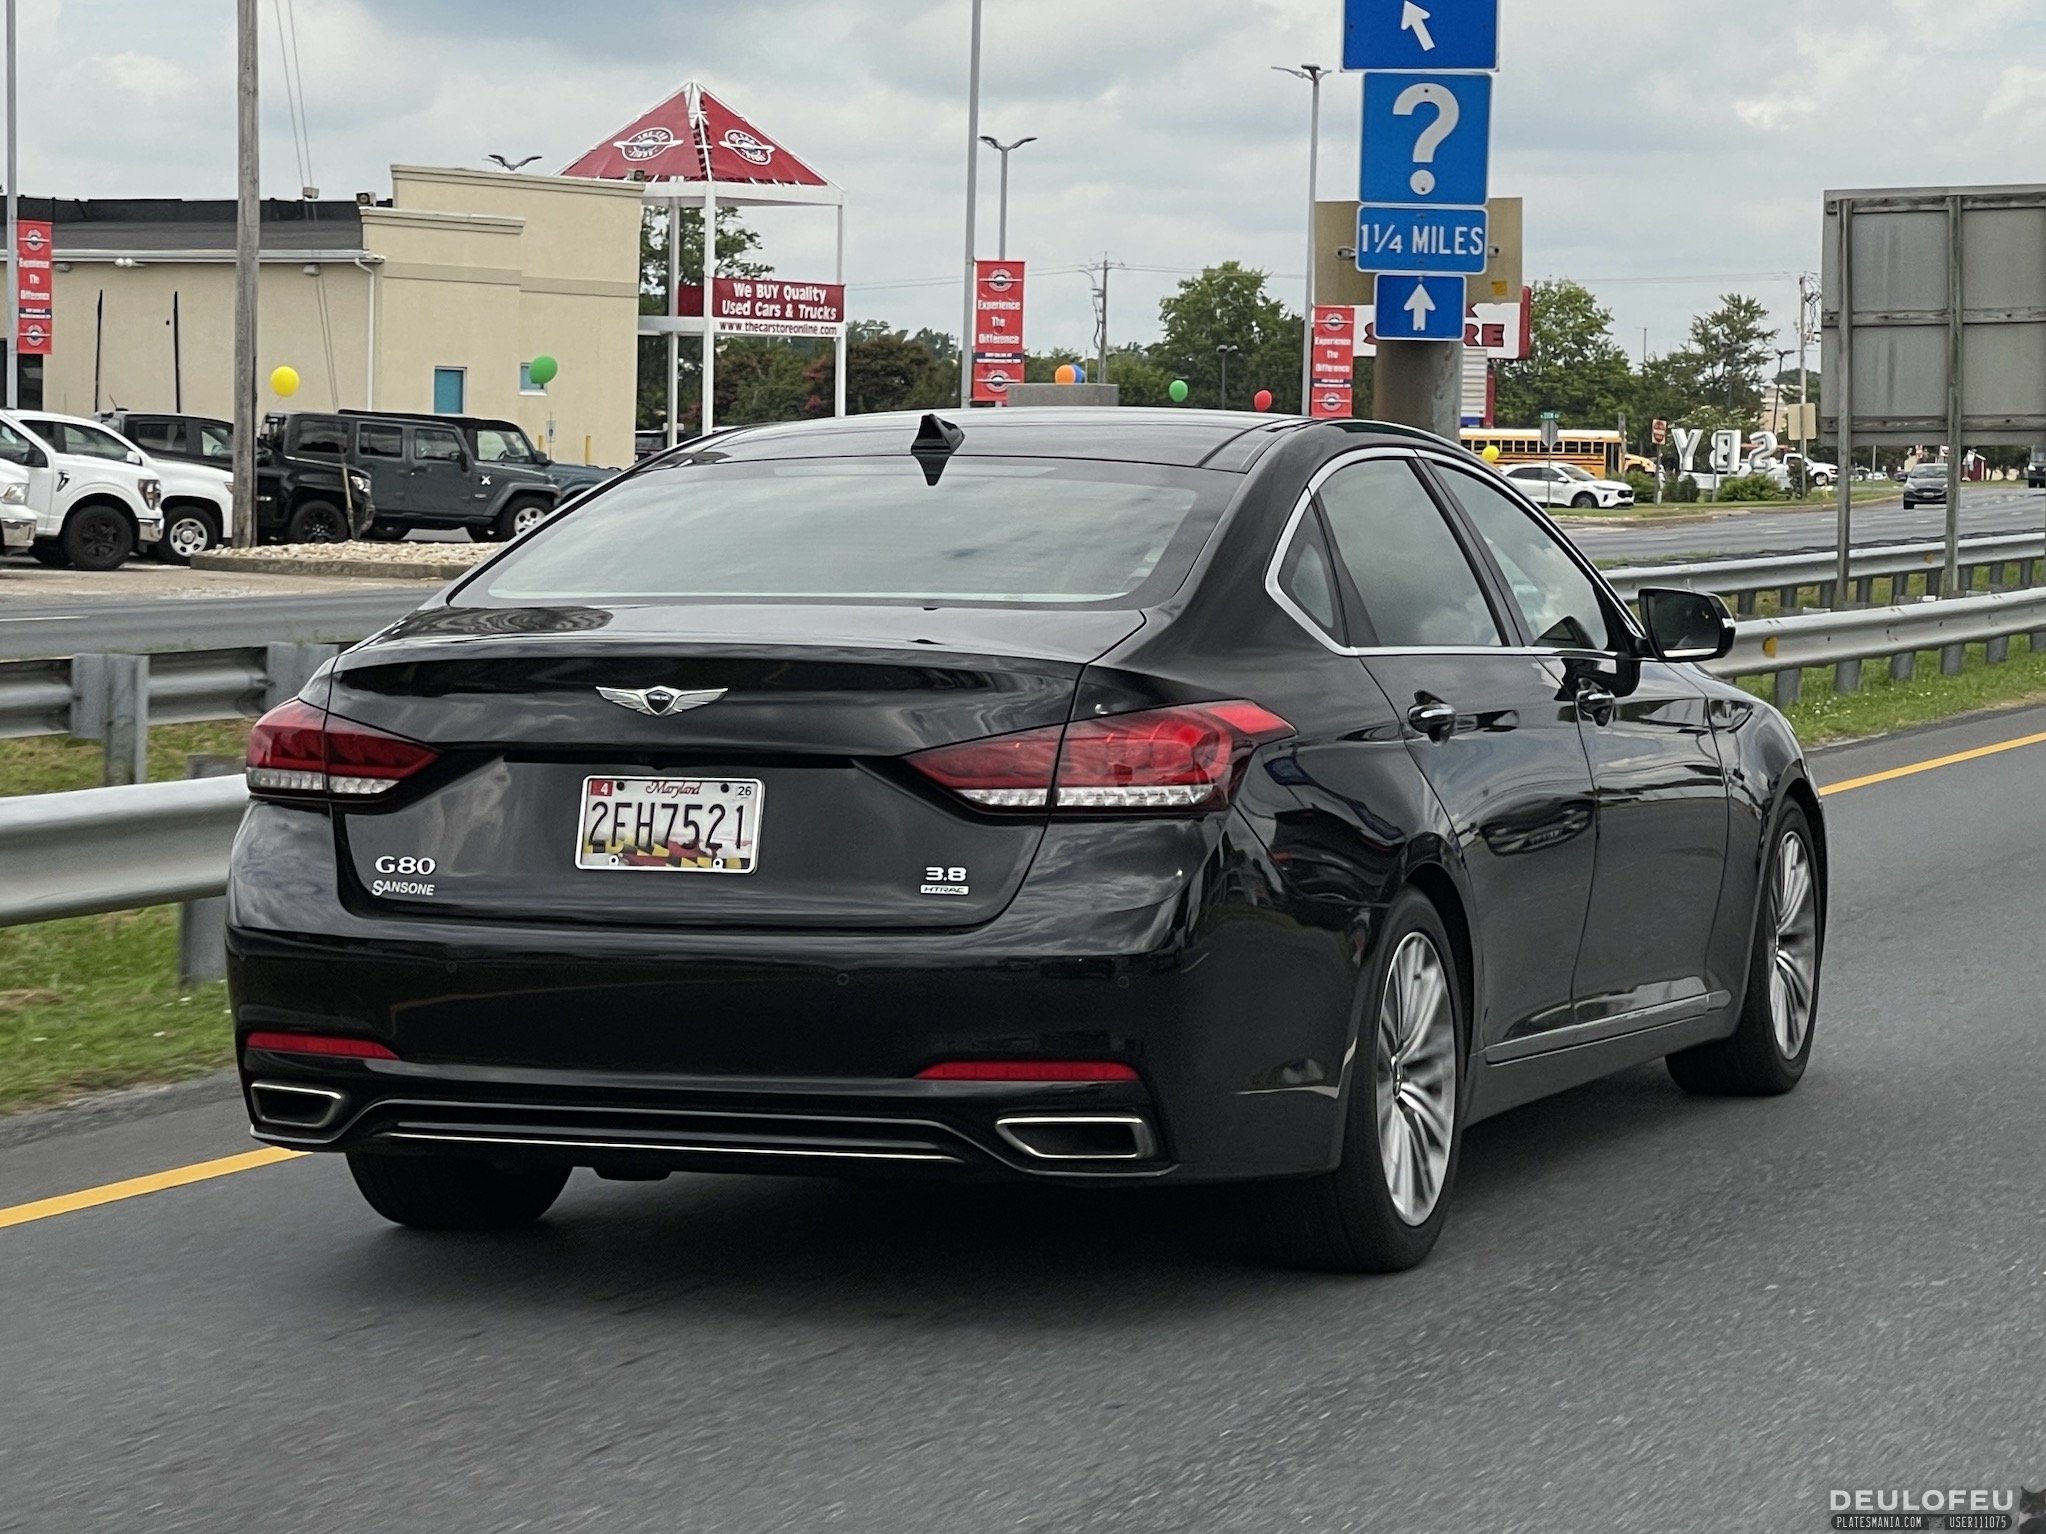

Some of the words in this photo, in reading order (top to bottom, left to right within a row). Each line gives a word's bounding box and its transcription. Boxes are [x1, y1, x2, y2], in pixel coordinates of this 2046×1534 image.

[1412, 225, 1483, 256] MILES
[733, 282, 752, 298] We
[756, 284, 779, 300] BUY
[783, 285, 826, 305] Quality
[722, 299, 751, 316] Used
[755, 302, 781, 318] Cars
[785, 303, 794, 318] &
[798, 304, 836, 320] Trucks
[977, 299, 1021, 311] Experience
[719, 321, 838, 336] www.thecarstoreonline.com
[991, 316, 1006, 327] The
[978, 333, 1020, 345] Difference
[601, 782, 609, 796] 4
[646, 781, 701, 799] Maryland
[738, 786, 752, 797] 26
[588, 801, 744, 850] 2FH7521
[375, 855, 436, 876] G80
[925, 866, 967, 882] 3.8
[371, 879, 436, 897] SANSONE
